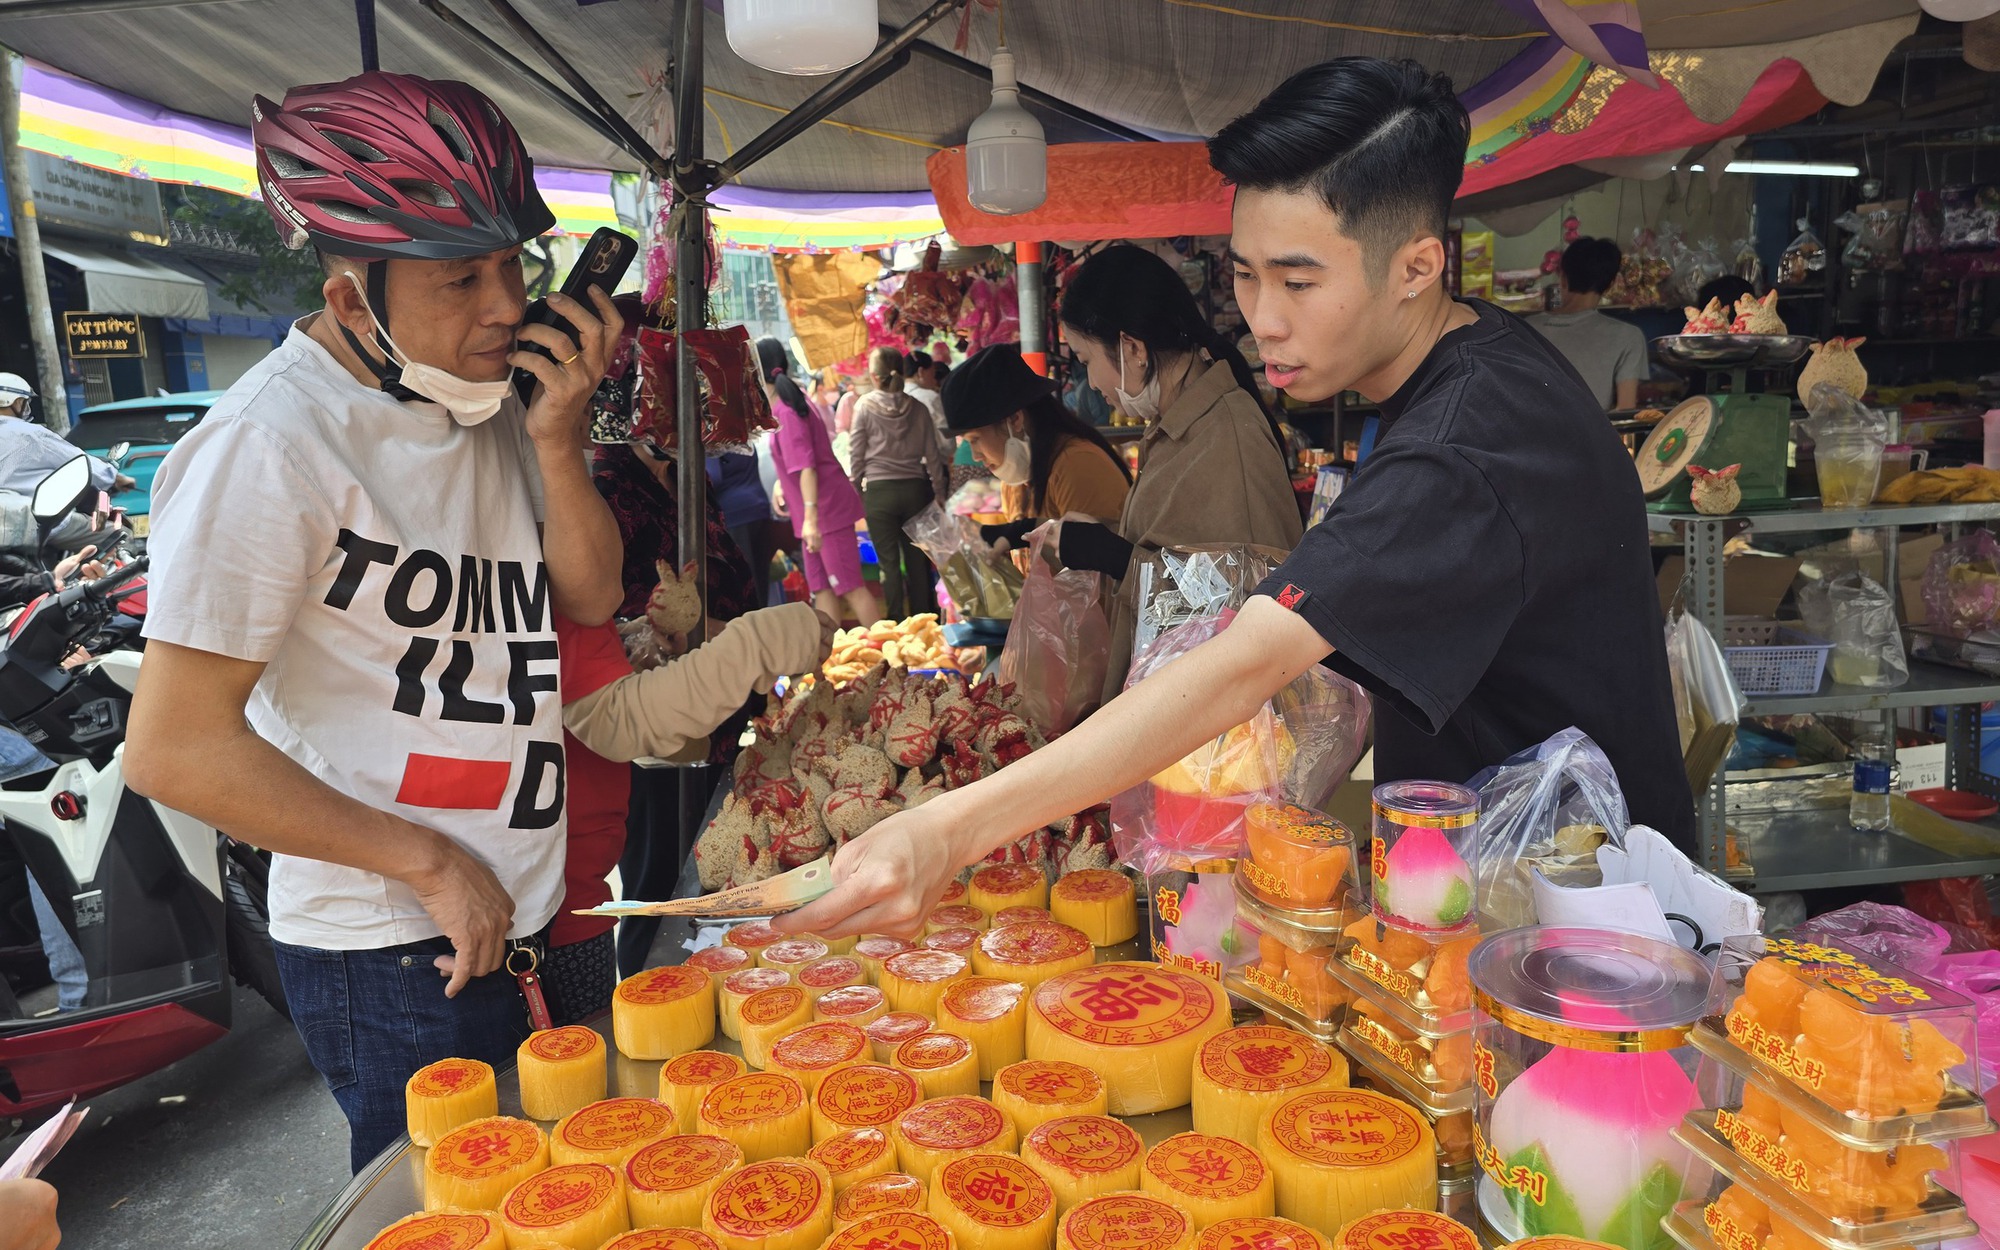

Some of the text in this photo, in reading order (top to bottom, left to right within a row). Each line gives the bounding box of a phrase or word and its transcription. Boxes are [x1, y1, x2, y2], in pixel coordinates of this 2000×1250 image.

[267, 181, 309, 226] GRS
[69, 318, 92, 336] CÁT
[323, 527, 558, 634] TOMM
[392, 636, 559, 726] ILF
[508, 740, 565, 830] D
[1156, 886, 1181, 926] 福
[1070, 974, 1179, 1022] 福
[1112, 1007, 1204, 1045] 合家平安
[1207, 1026, 1268, 1055] 新年發財
[683, 1059, 724, 1079] 發
[1473, 1041, 1498, 1099] 福
[1731, 1012, 1826, 1089] 新年發大財
[1022, 1070, 1078, 1098] 發
[458, 1131, 514, 1168] 福
[1174, 1148, 1235, 1187] 發
[965, 1168, 1025, 1210] 福
